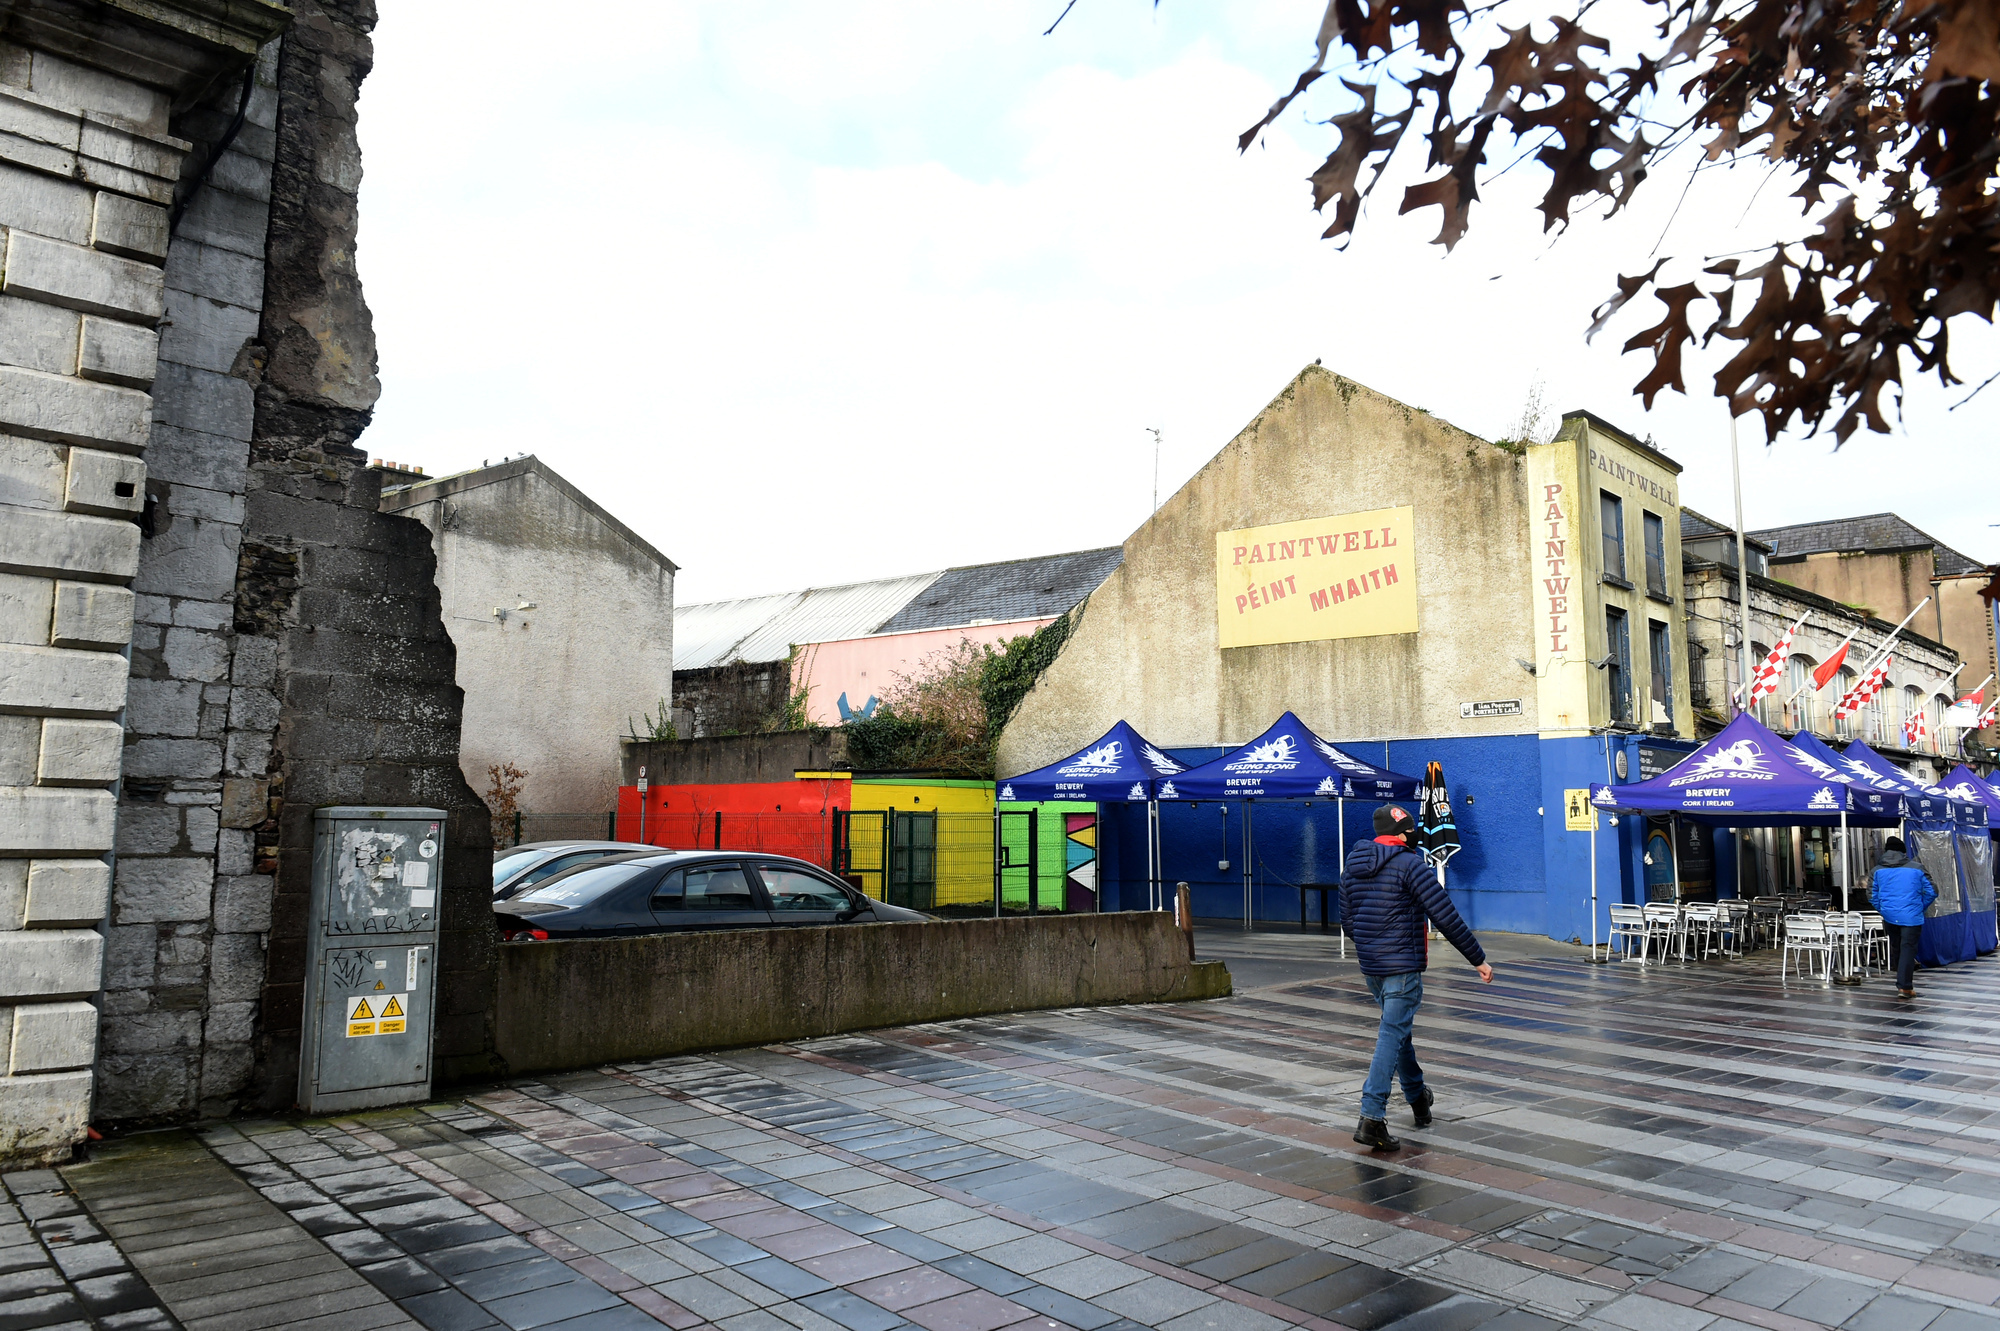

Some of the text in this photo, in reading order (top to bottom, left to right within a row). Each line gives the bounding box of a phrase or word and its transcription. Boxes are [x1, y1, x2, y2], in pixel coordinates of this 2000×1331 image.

[1589, 448, 1675, 508] PAINTWELL
[1232, 526, 1397, 566] PAINTWELL
[1543, 483, 1571, 652] PAINTWELL
[1235, 563, 1399, 615] PÉINT MHAITH
[1226, 778, 1262, 786] BREWERY
[1668, 771, 1774, 787] RISING SONS
[1685, 788, 1731, 797] BREWERY
